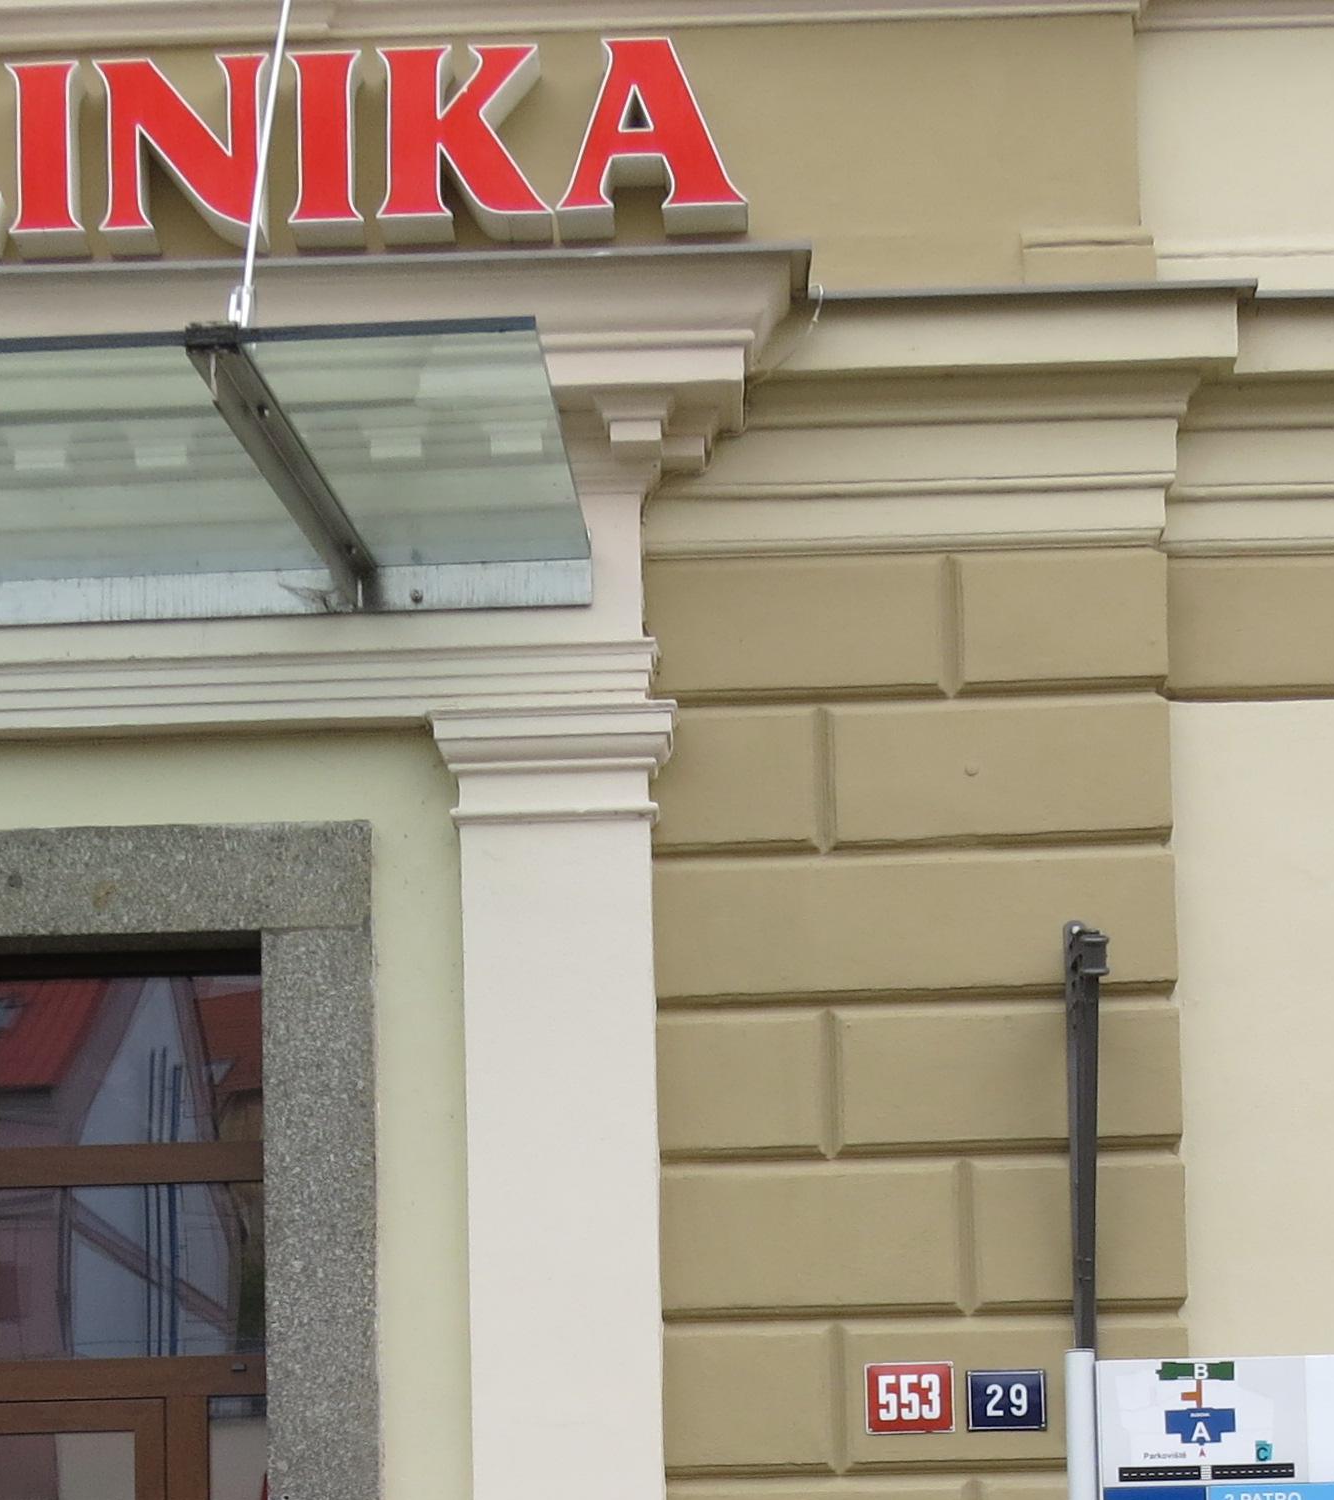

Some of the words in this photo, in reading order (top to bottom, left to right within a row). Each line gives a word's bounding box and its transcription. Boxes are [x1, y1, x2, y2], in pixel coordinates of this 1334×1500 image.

[1193, 1363, 1209, 1380] B
[878, 1374, 941, 1421] 553
[986, 1384, 1028, 1417] 29
[1191, 1421, 1211, 1442] A
[1256, 1447, 1268, 1462] C
